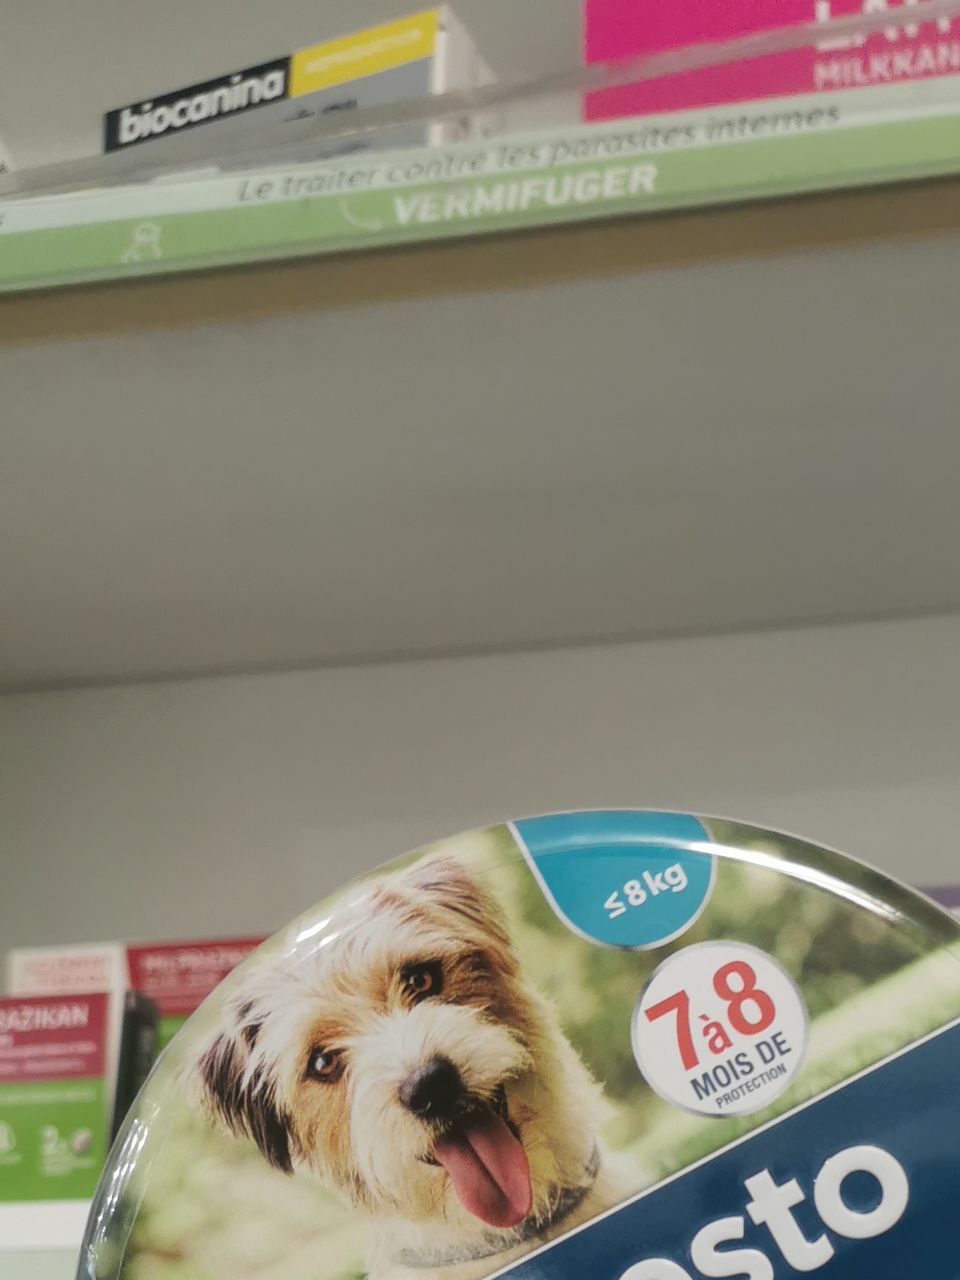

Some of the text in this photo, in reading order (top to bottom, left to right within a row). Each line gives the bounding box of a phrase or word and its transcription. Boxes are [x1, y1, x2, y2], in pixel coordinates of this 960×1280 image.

[117, 64, 287, 144] biocanina
[239, 173, 275, 202] Le
[281, 162, 377, 198] traiter
[387, 149, 488, 184] contre
[497, 140, 541, 172] les
[549, 124, 698, 169] parasites
[702, 103, 841, 139] internes
[392, 163, 658, 227] VERMIFUGER
[689, 1031, 793, 1103] MOIS DE
[714, 1062, 789, 1110] PROTECTION
